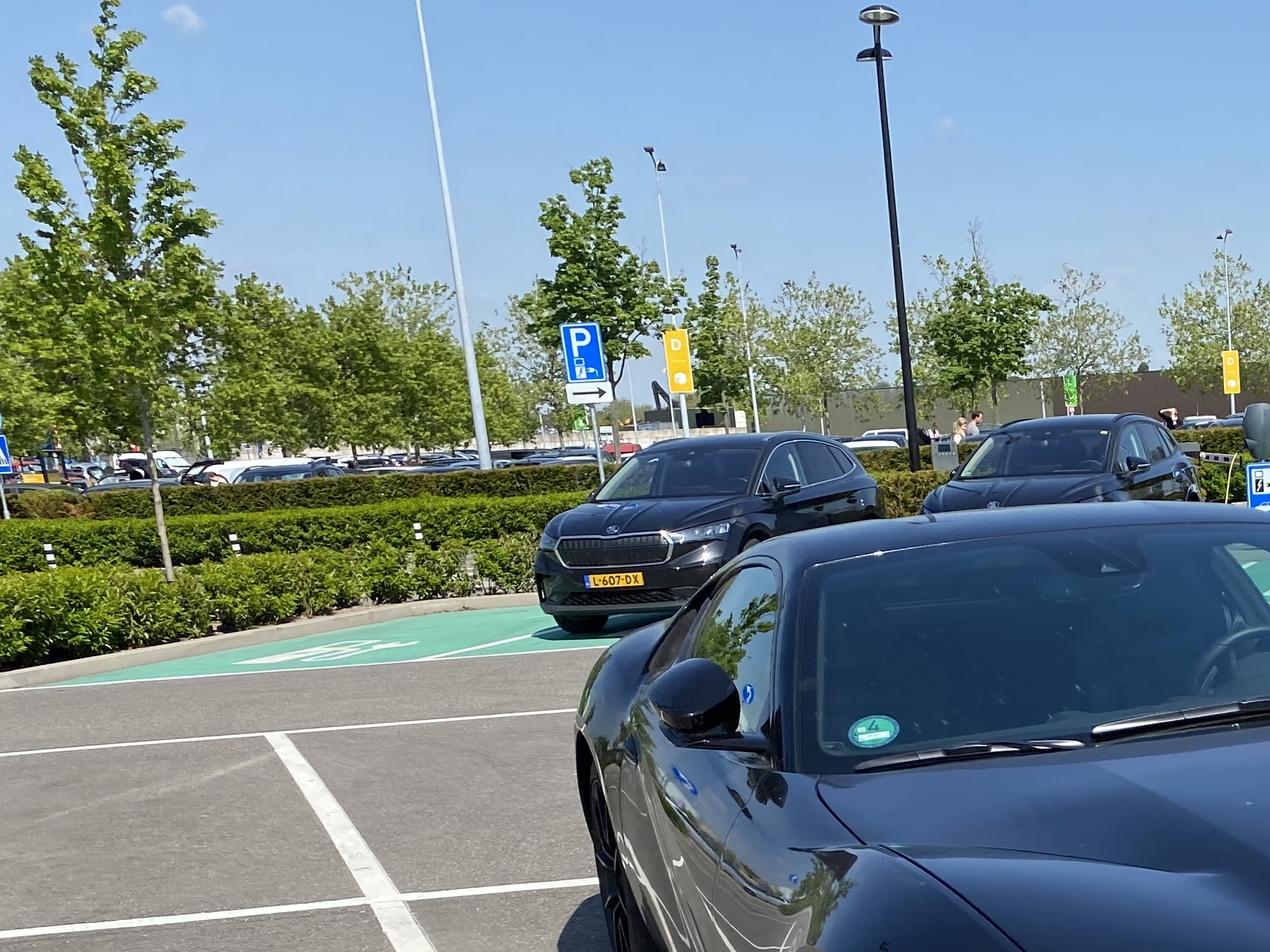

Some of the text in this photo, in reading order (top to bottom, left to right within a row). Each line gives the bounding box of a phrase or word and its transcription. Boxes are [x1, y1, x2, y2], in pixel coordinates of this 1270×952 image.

[569, 328, 591, 357] P
[671, 338, 682, 351] D
[1227, 357, 1234, 365] D
[592, 574, 639, 587] L-607-DX
[868, 720, 880, 731] 4
